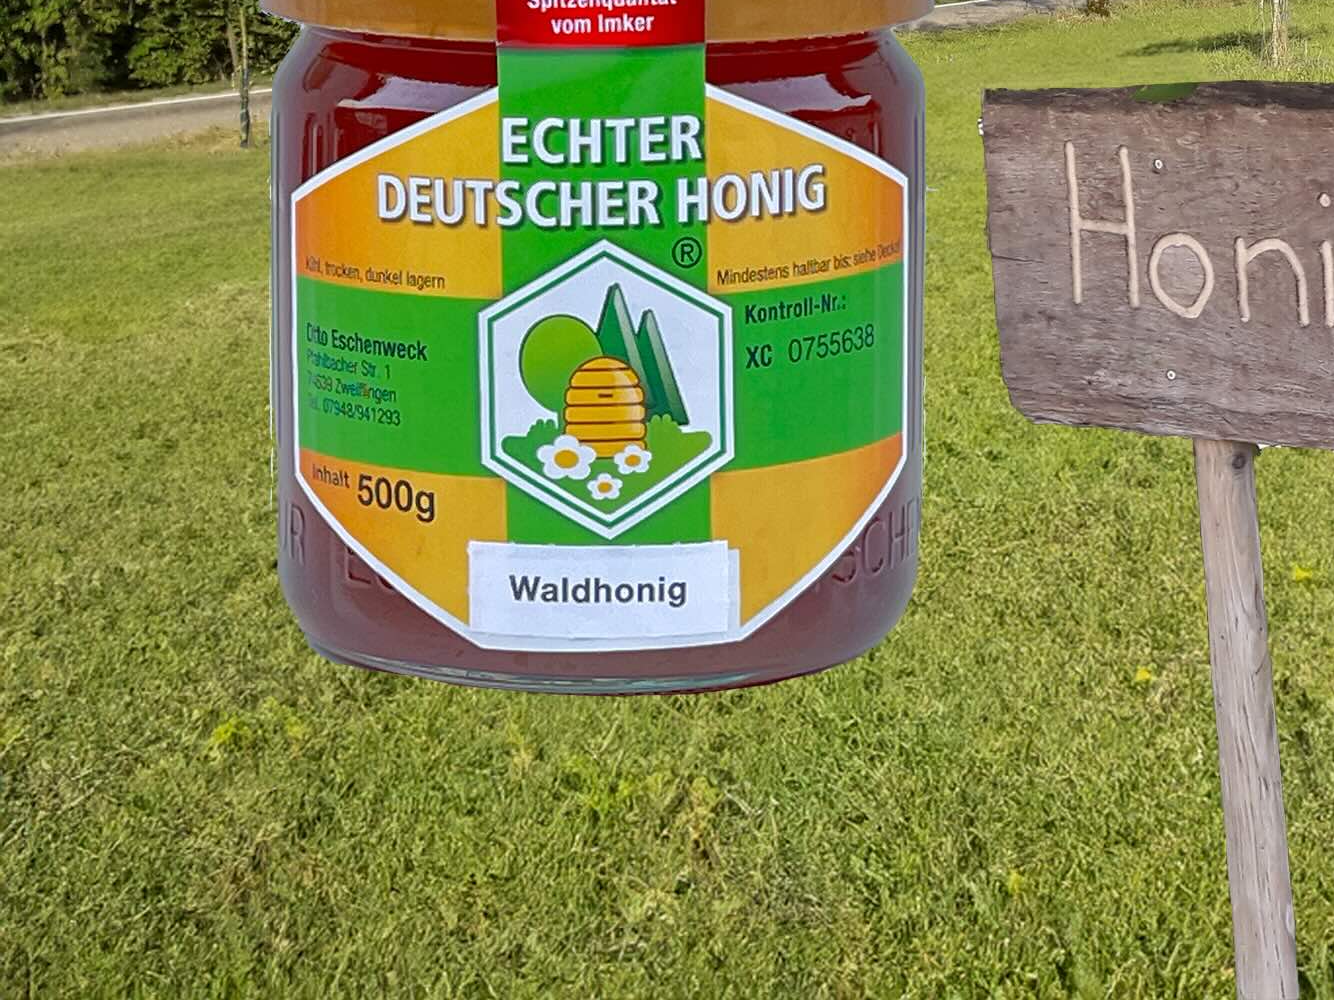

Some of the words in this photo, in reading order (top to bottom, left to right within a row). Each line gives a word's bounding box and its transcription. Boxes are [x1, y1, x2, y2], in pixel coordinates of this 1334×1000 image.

[551, 18, 592, 35] vom
[598, 14, 655, 33] Imker
[501, 115, 703, 163] ECHTER
[376, 173, 661, 228] DEUTSCHER
[677, 164, 826, 225] HONIG
[365, 266, 403, 286] dunkel
[406, 270, 446, 291] lagern
[716, 263, 790, 286] Mindestens
[792, 257, 831, 277] haltbar
[744, 293, 847, 325] Kontroll-Nr.:
[331, 328, 428, 362] Eschenweck
[744, 343, 773, 369] XC
[787, 323, 875, 364] 0755638
[312, 463, 350, 489] Inhalt
[357, 473, 436, 523] 500g
[508, 574, 688, 608] Waldhonig
